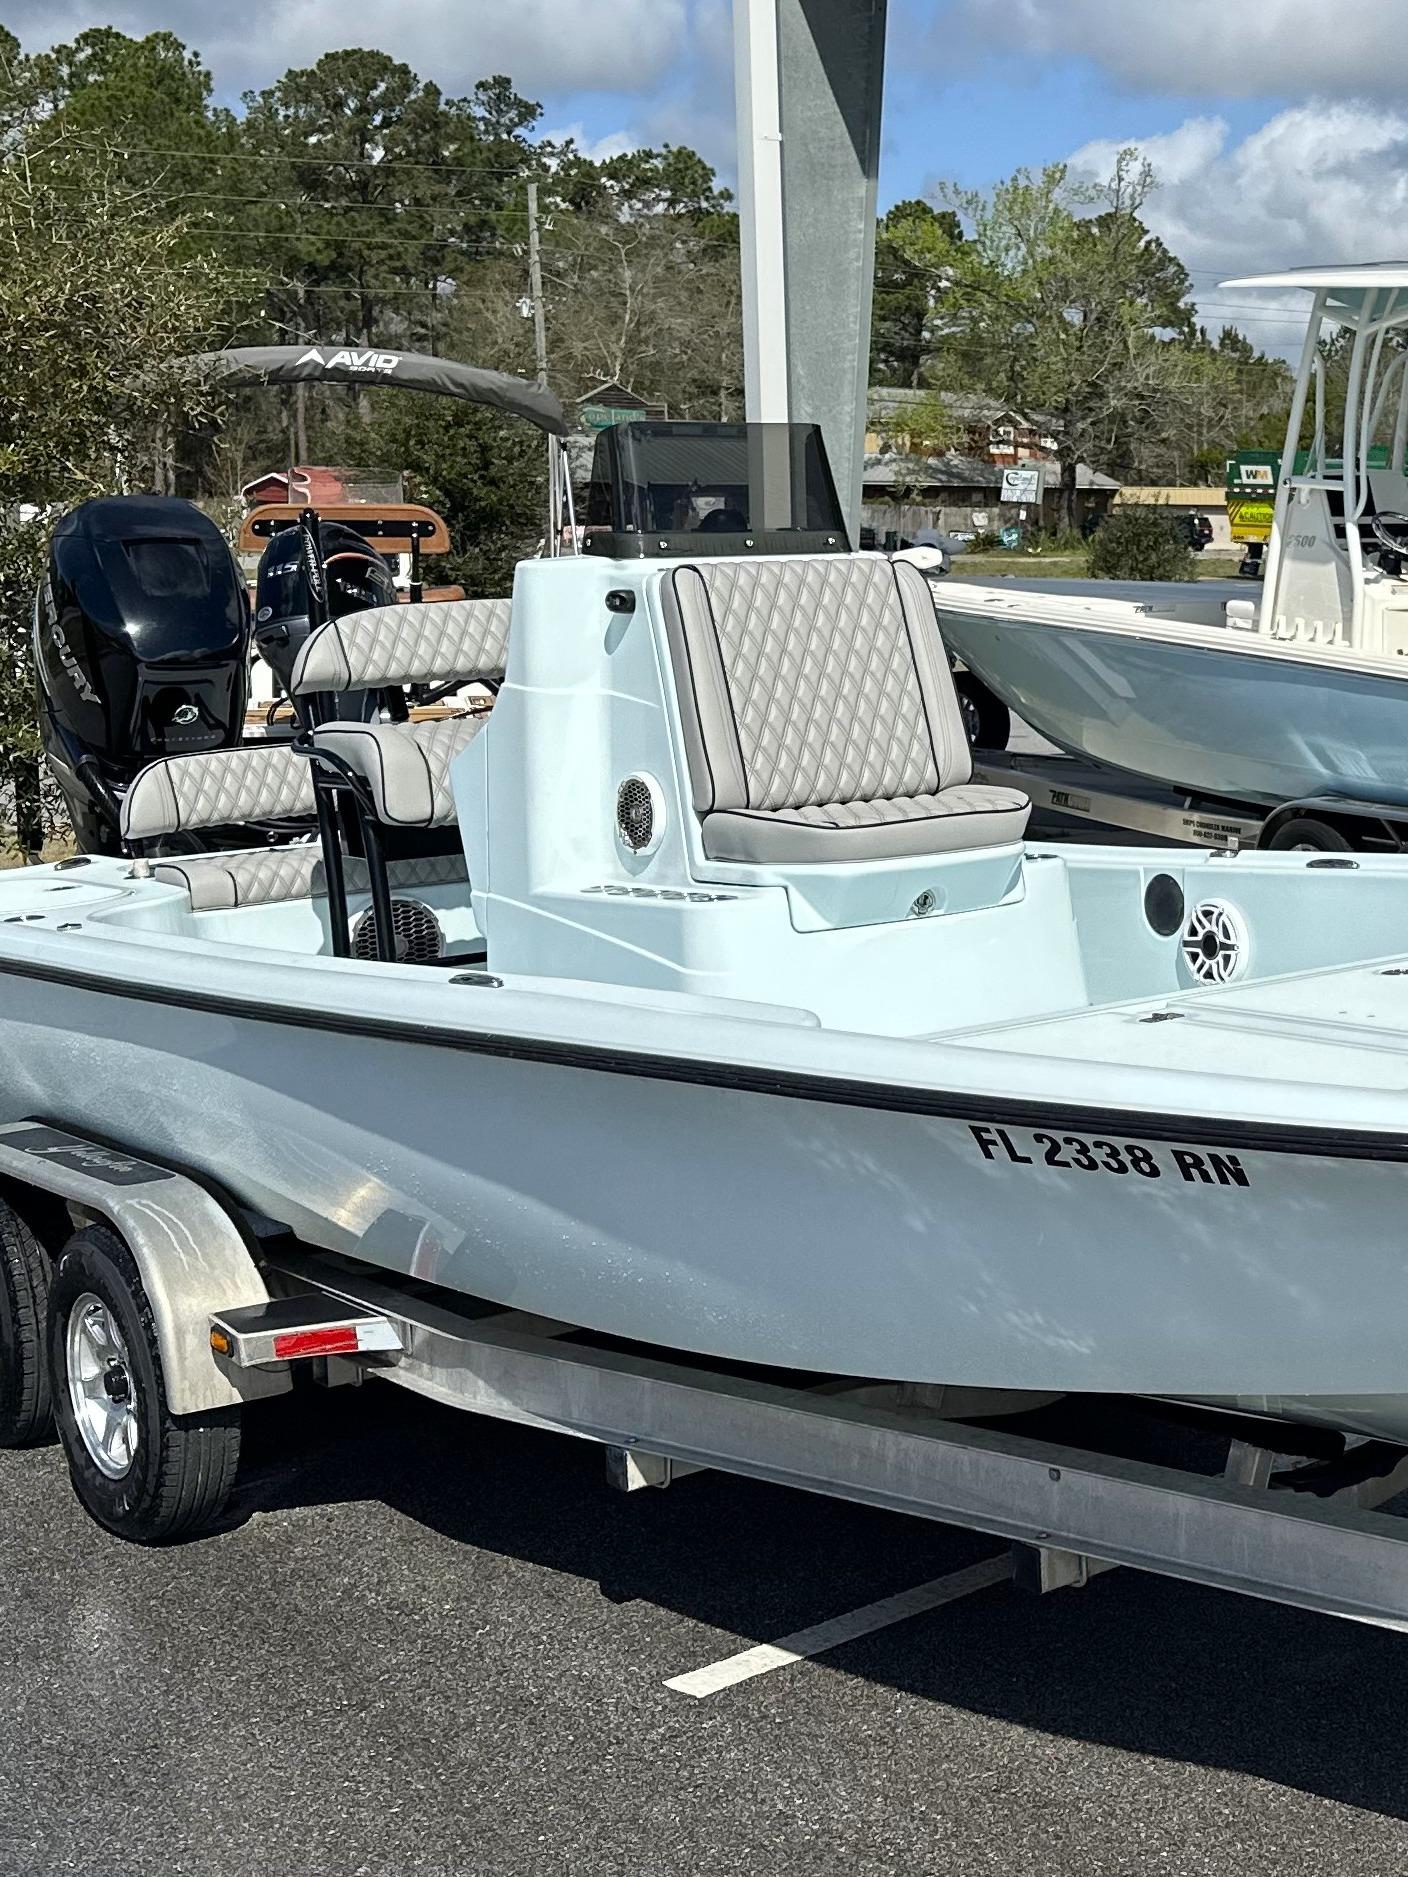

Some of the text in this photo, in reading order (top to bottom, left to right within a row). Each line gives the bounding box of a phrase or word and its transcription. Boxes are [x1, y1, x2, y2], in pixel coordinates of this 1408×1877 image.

[325, 350, 399, 369] AVID
[1245, 469, 1269, 481] WM
[968, 1124, 1251, 1188] FL 2338 RN
